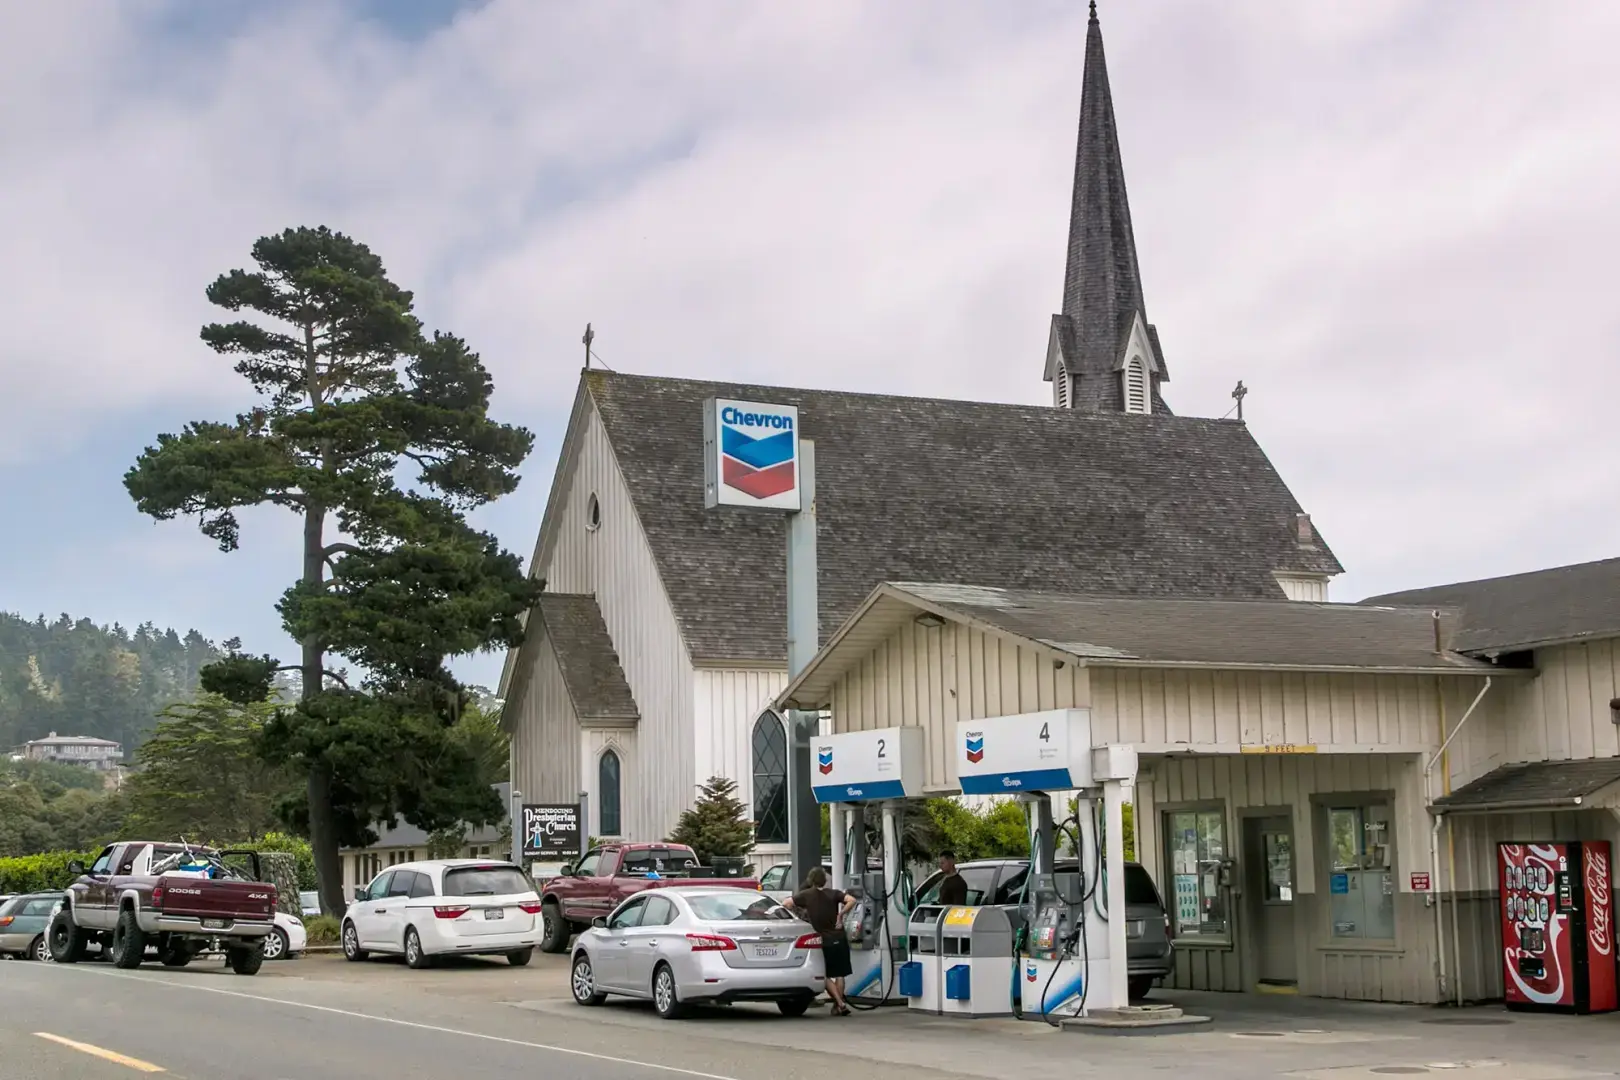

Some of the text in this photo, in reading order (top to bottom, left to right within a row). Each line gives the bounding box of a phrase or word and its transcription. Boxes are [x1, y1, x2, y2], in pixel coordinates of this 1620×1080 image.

[721, 407, 793, 429] Chevron
[1039, 722, 1050, 743] 4
[877, 739, 886, 758] 2
[1275, 744, 1296, 752] FEET
[546, 821, 576, 835] Church
